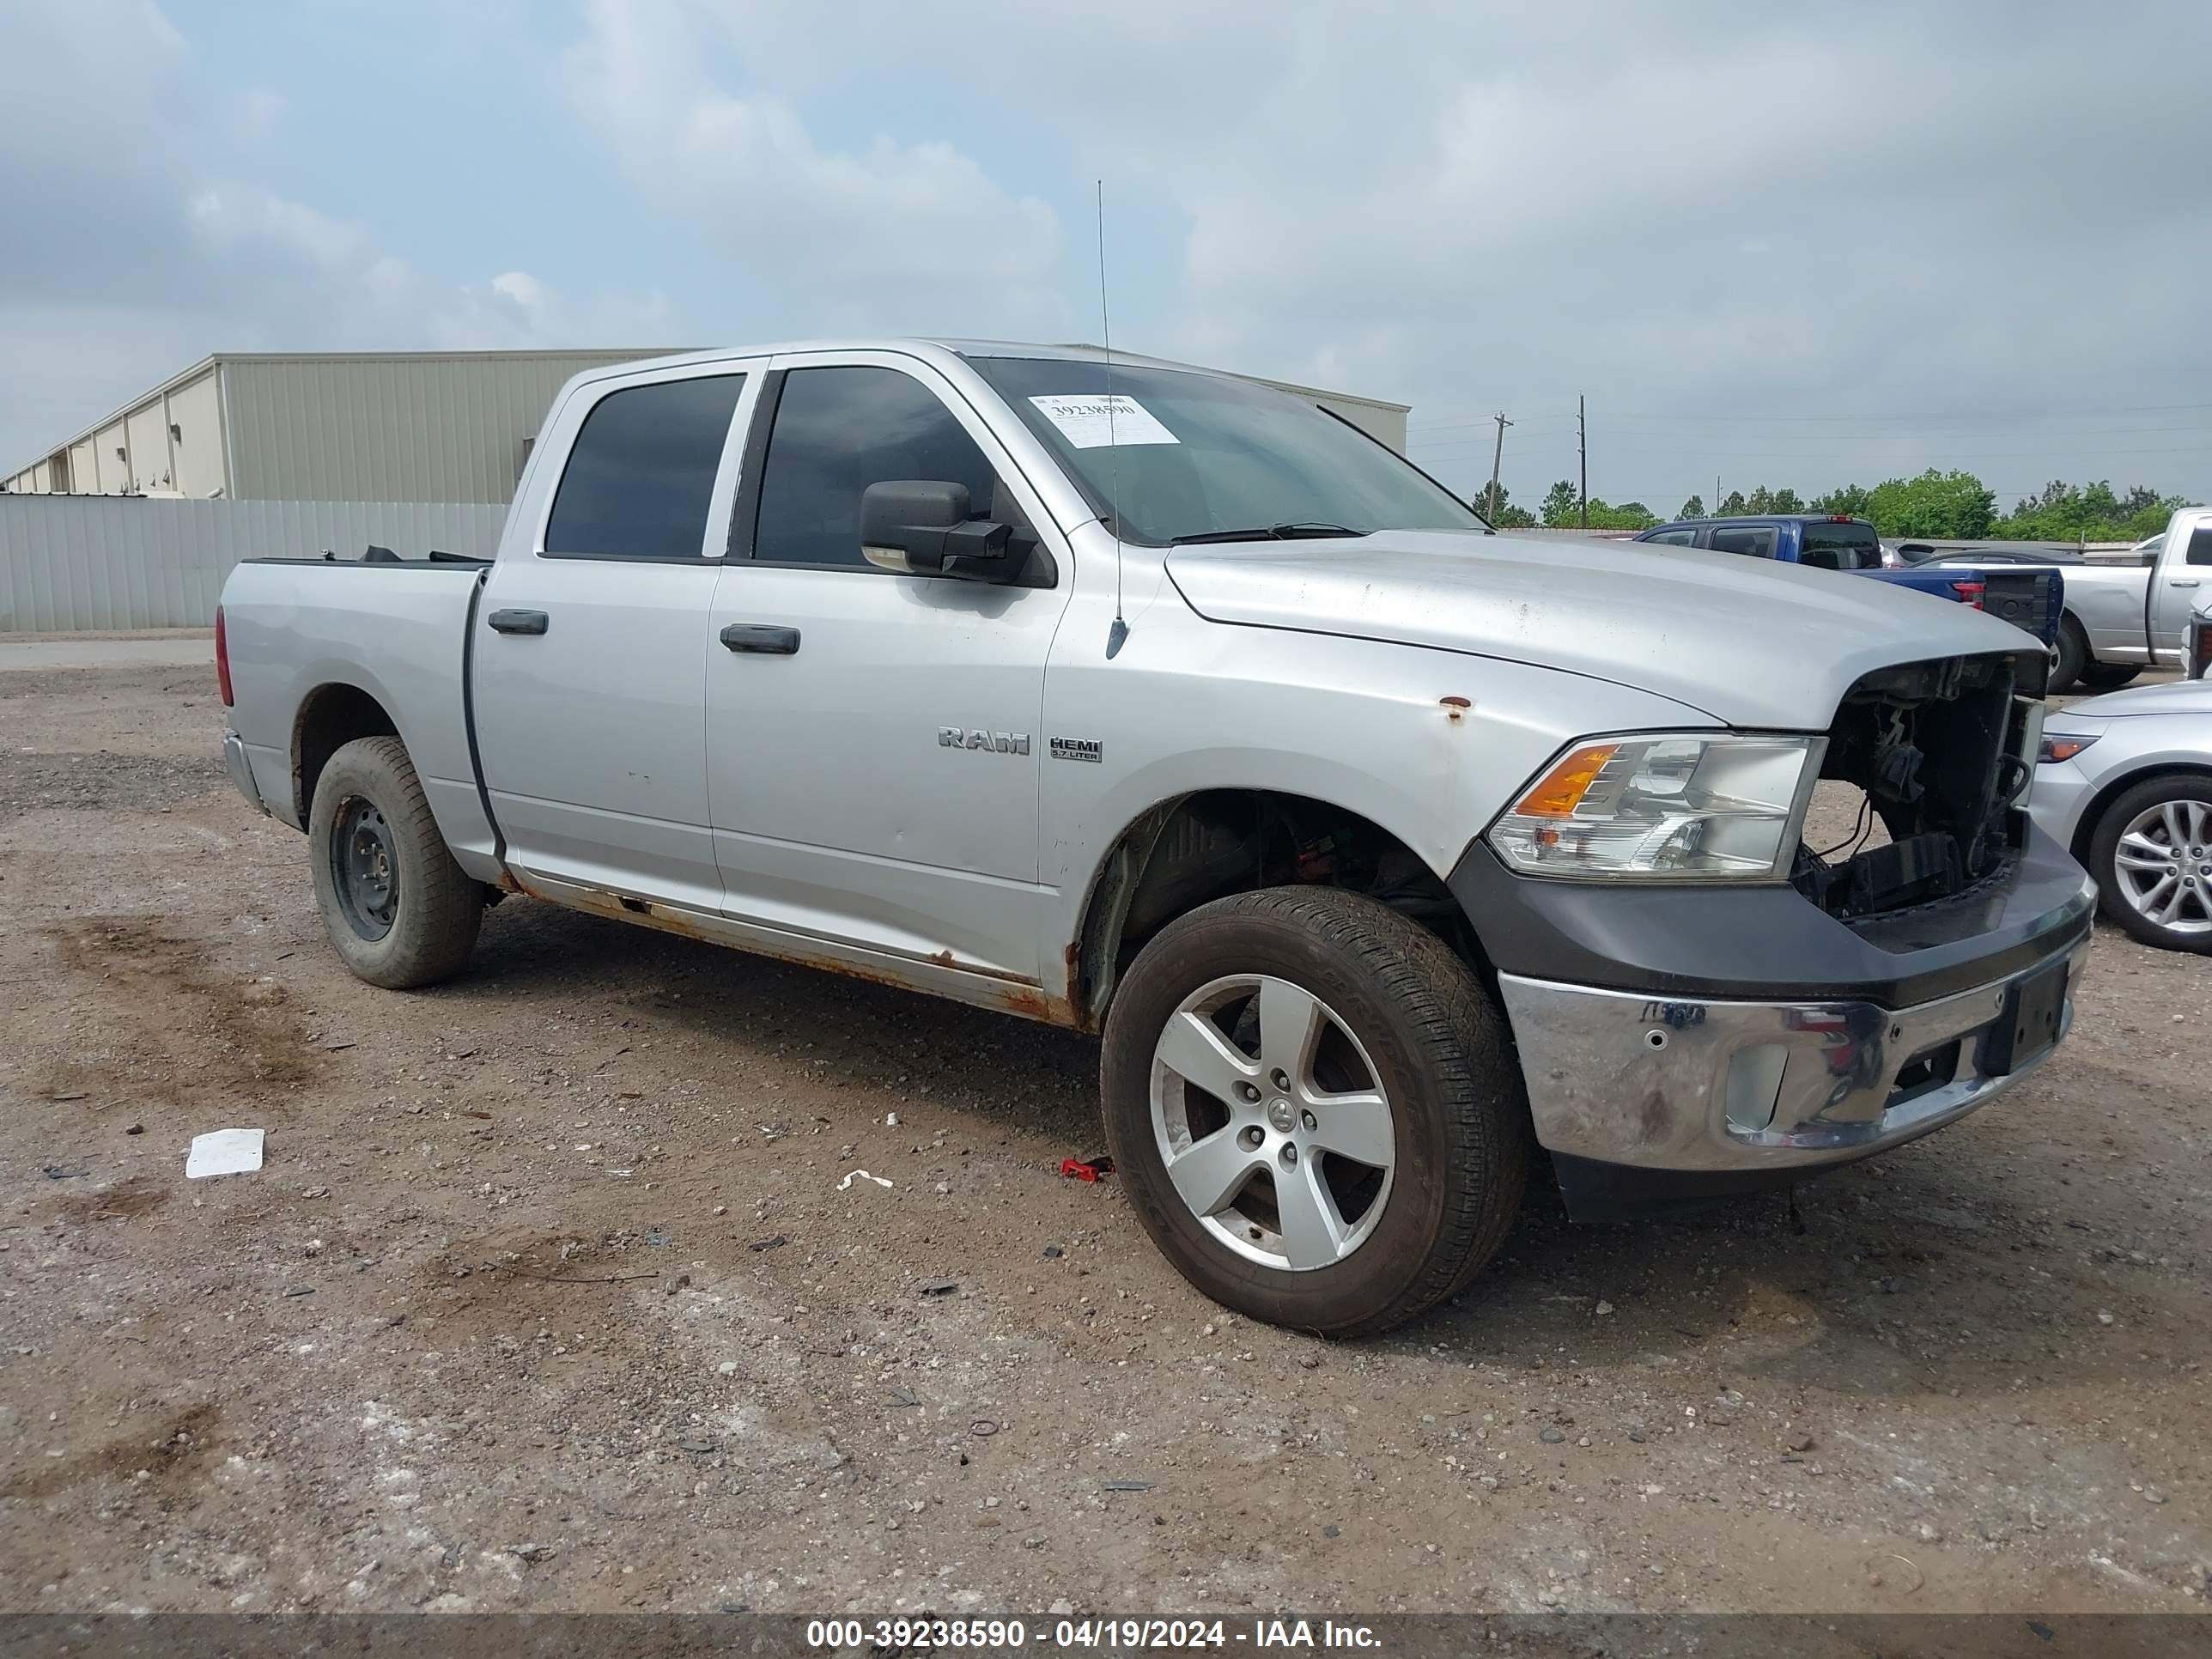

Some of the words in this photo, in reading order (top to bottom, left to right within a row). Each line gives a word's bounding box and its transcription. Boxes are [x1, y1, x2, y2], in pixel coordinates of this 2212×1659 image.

[1051, 405, 1135, 416] 39238590
[939, 726, 1030, 756] RAM
[1050, 737, 1099, 752] HEMI
[1070, 751, 1097, 760] LITER
